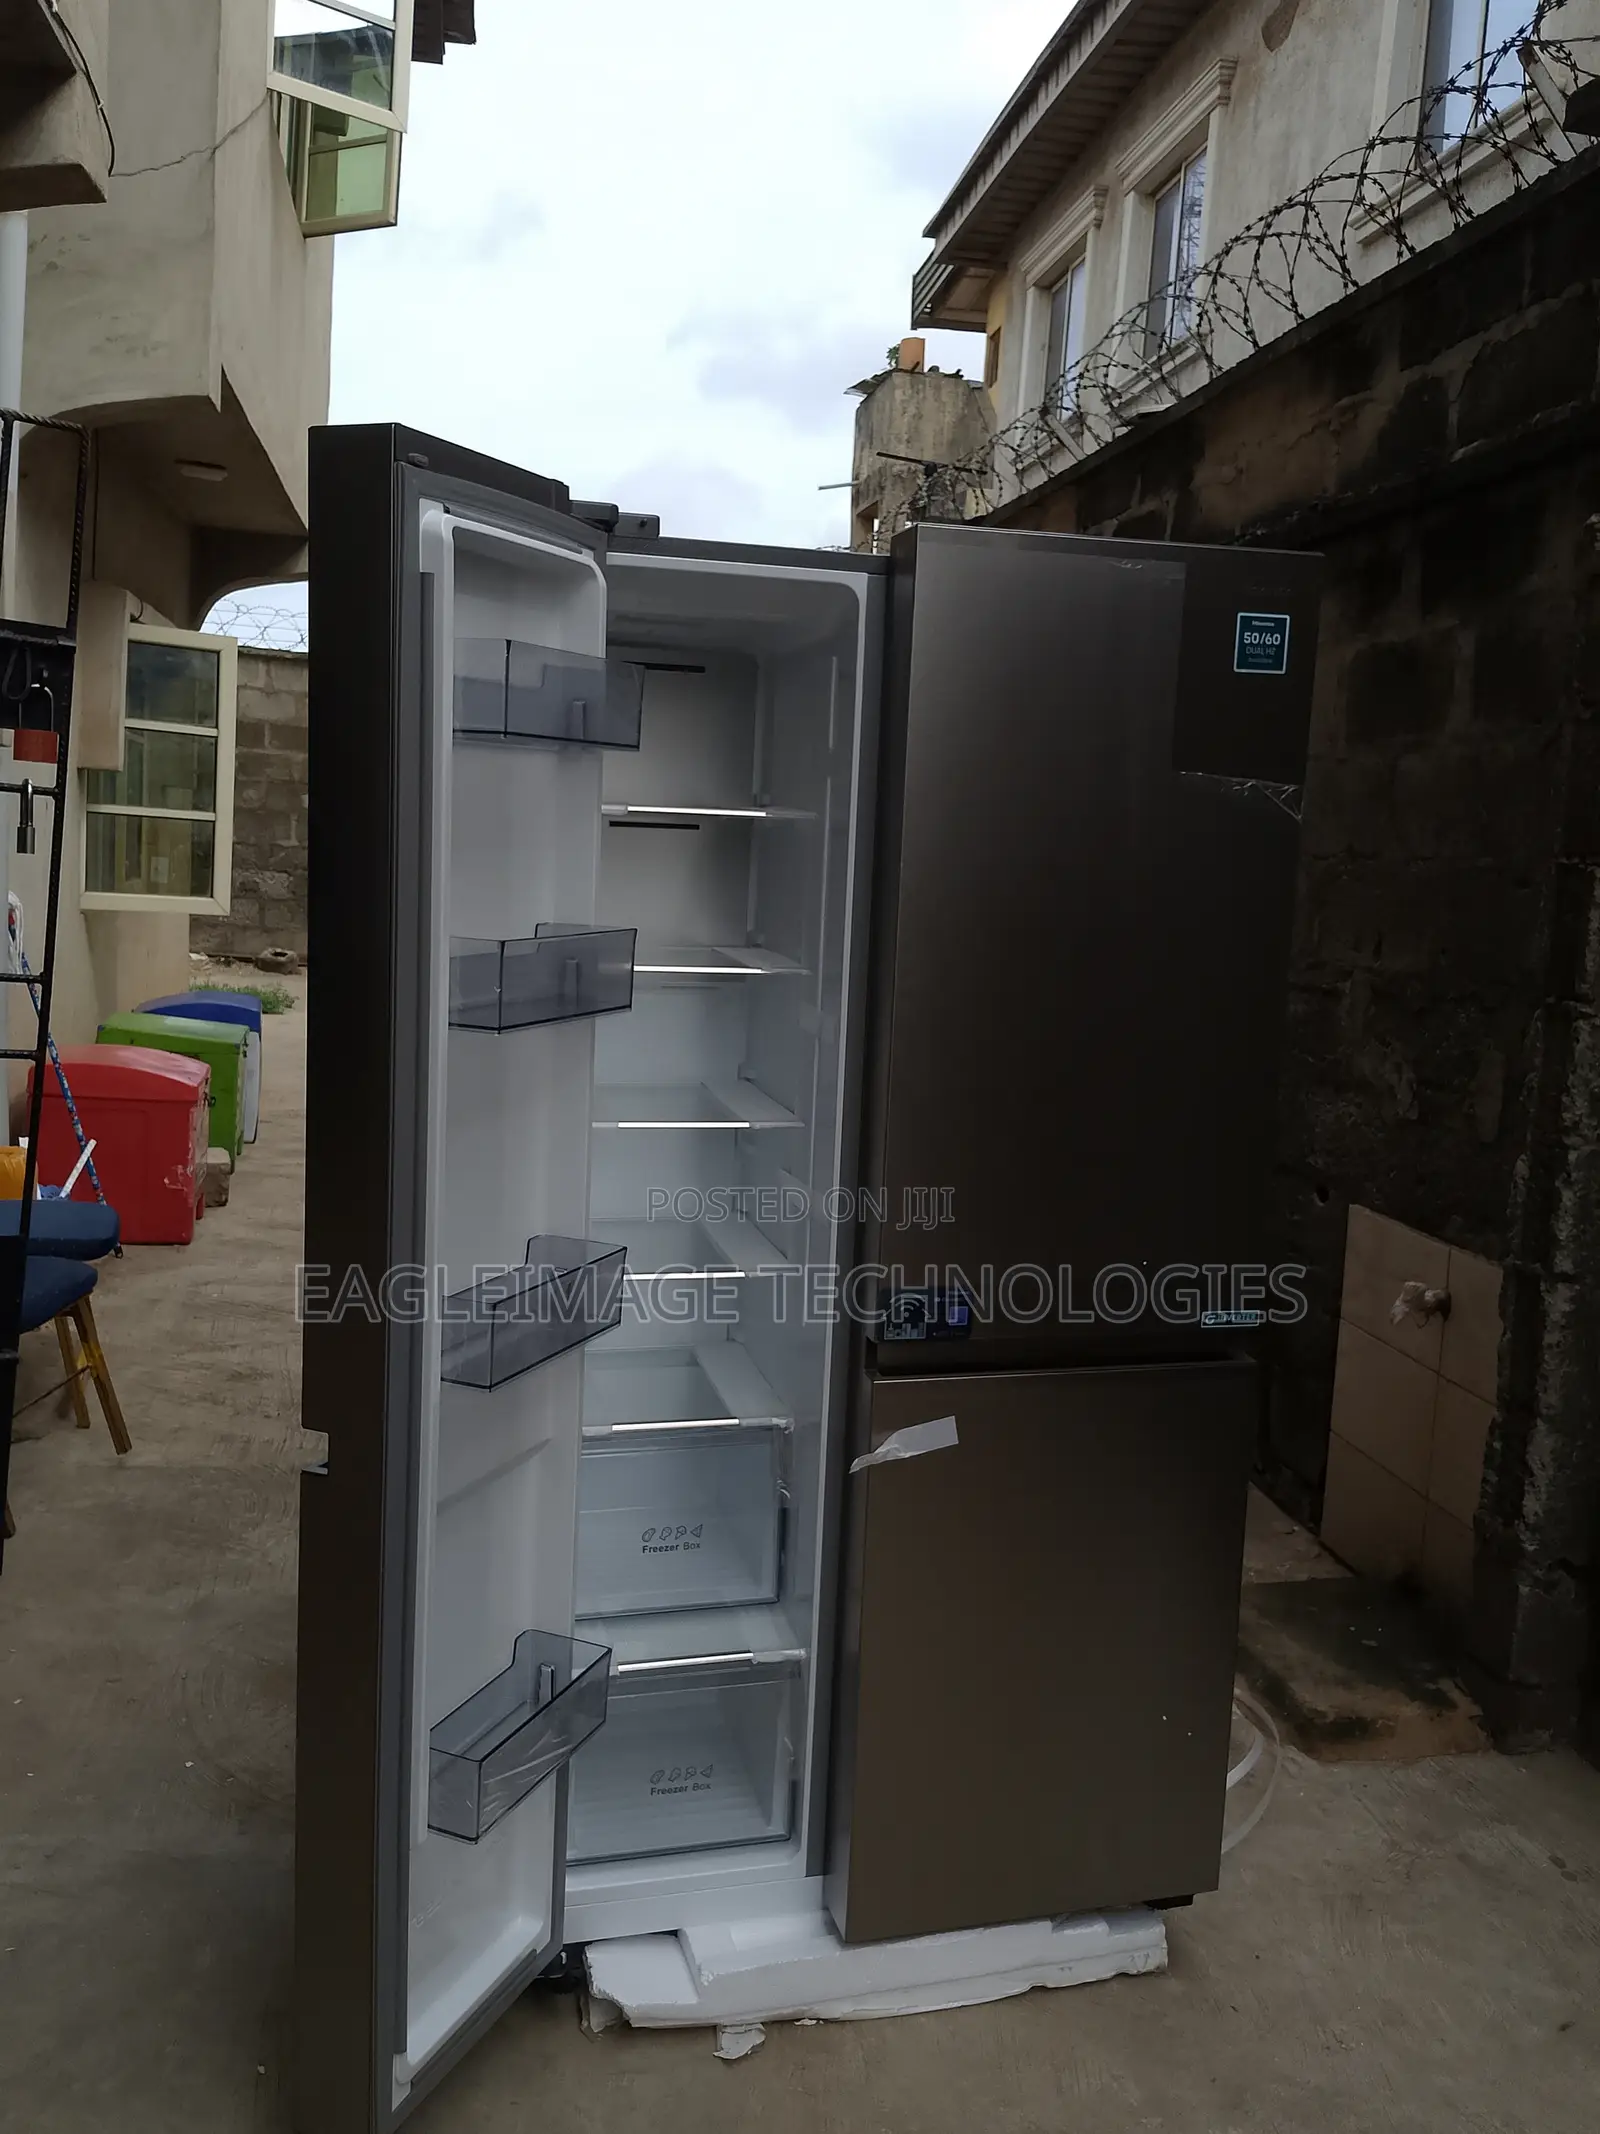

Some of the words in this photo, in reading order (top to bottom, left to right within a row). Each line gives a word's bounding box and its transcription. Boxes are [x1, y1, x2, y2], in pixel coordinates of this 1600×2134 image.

[1243, 632, 1281, 645] 50/60
[1245, 646, 1265, 656] DUAL
[642, 1543, 680, 1554] Freezer
[683, 1541, 701, 1551] Box
[650, 1784, 689, 1796] Freezer
[692, 1781, 712, 1791] Box
